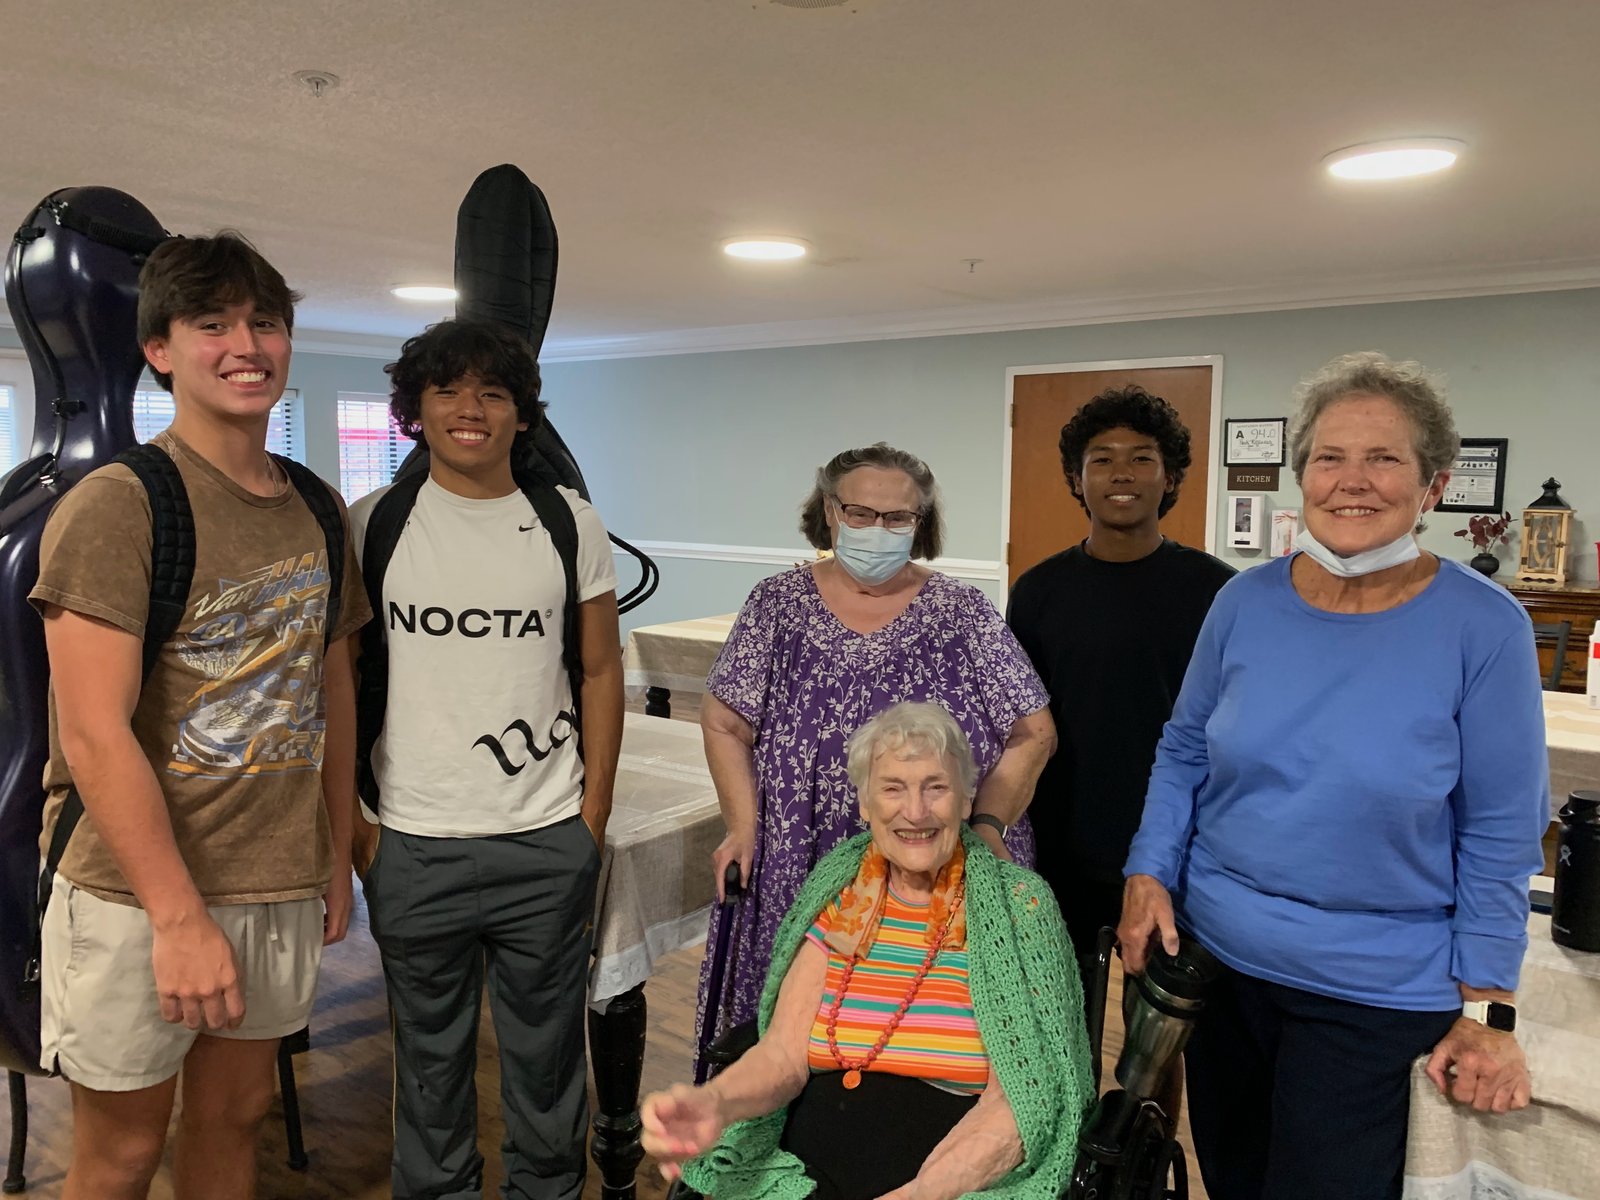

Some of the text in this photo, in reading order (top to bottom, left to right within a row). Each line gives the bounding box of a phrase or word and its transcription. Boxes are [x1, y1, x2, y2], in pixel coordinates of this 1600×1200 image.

[1236, 430, 1244, 439] A
[1236, 475, 1271, 483] KITCHEN
[388, 601, 545, 638] NOCTA
